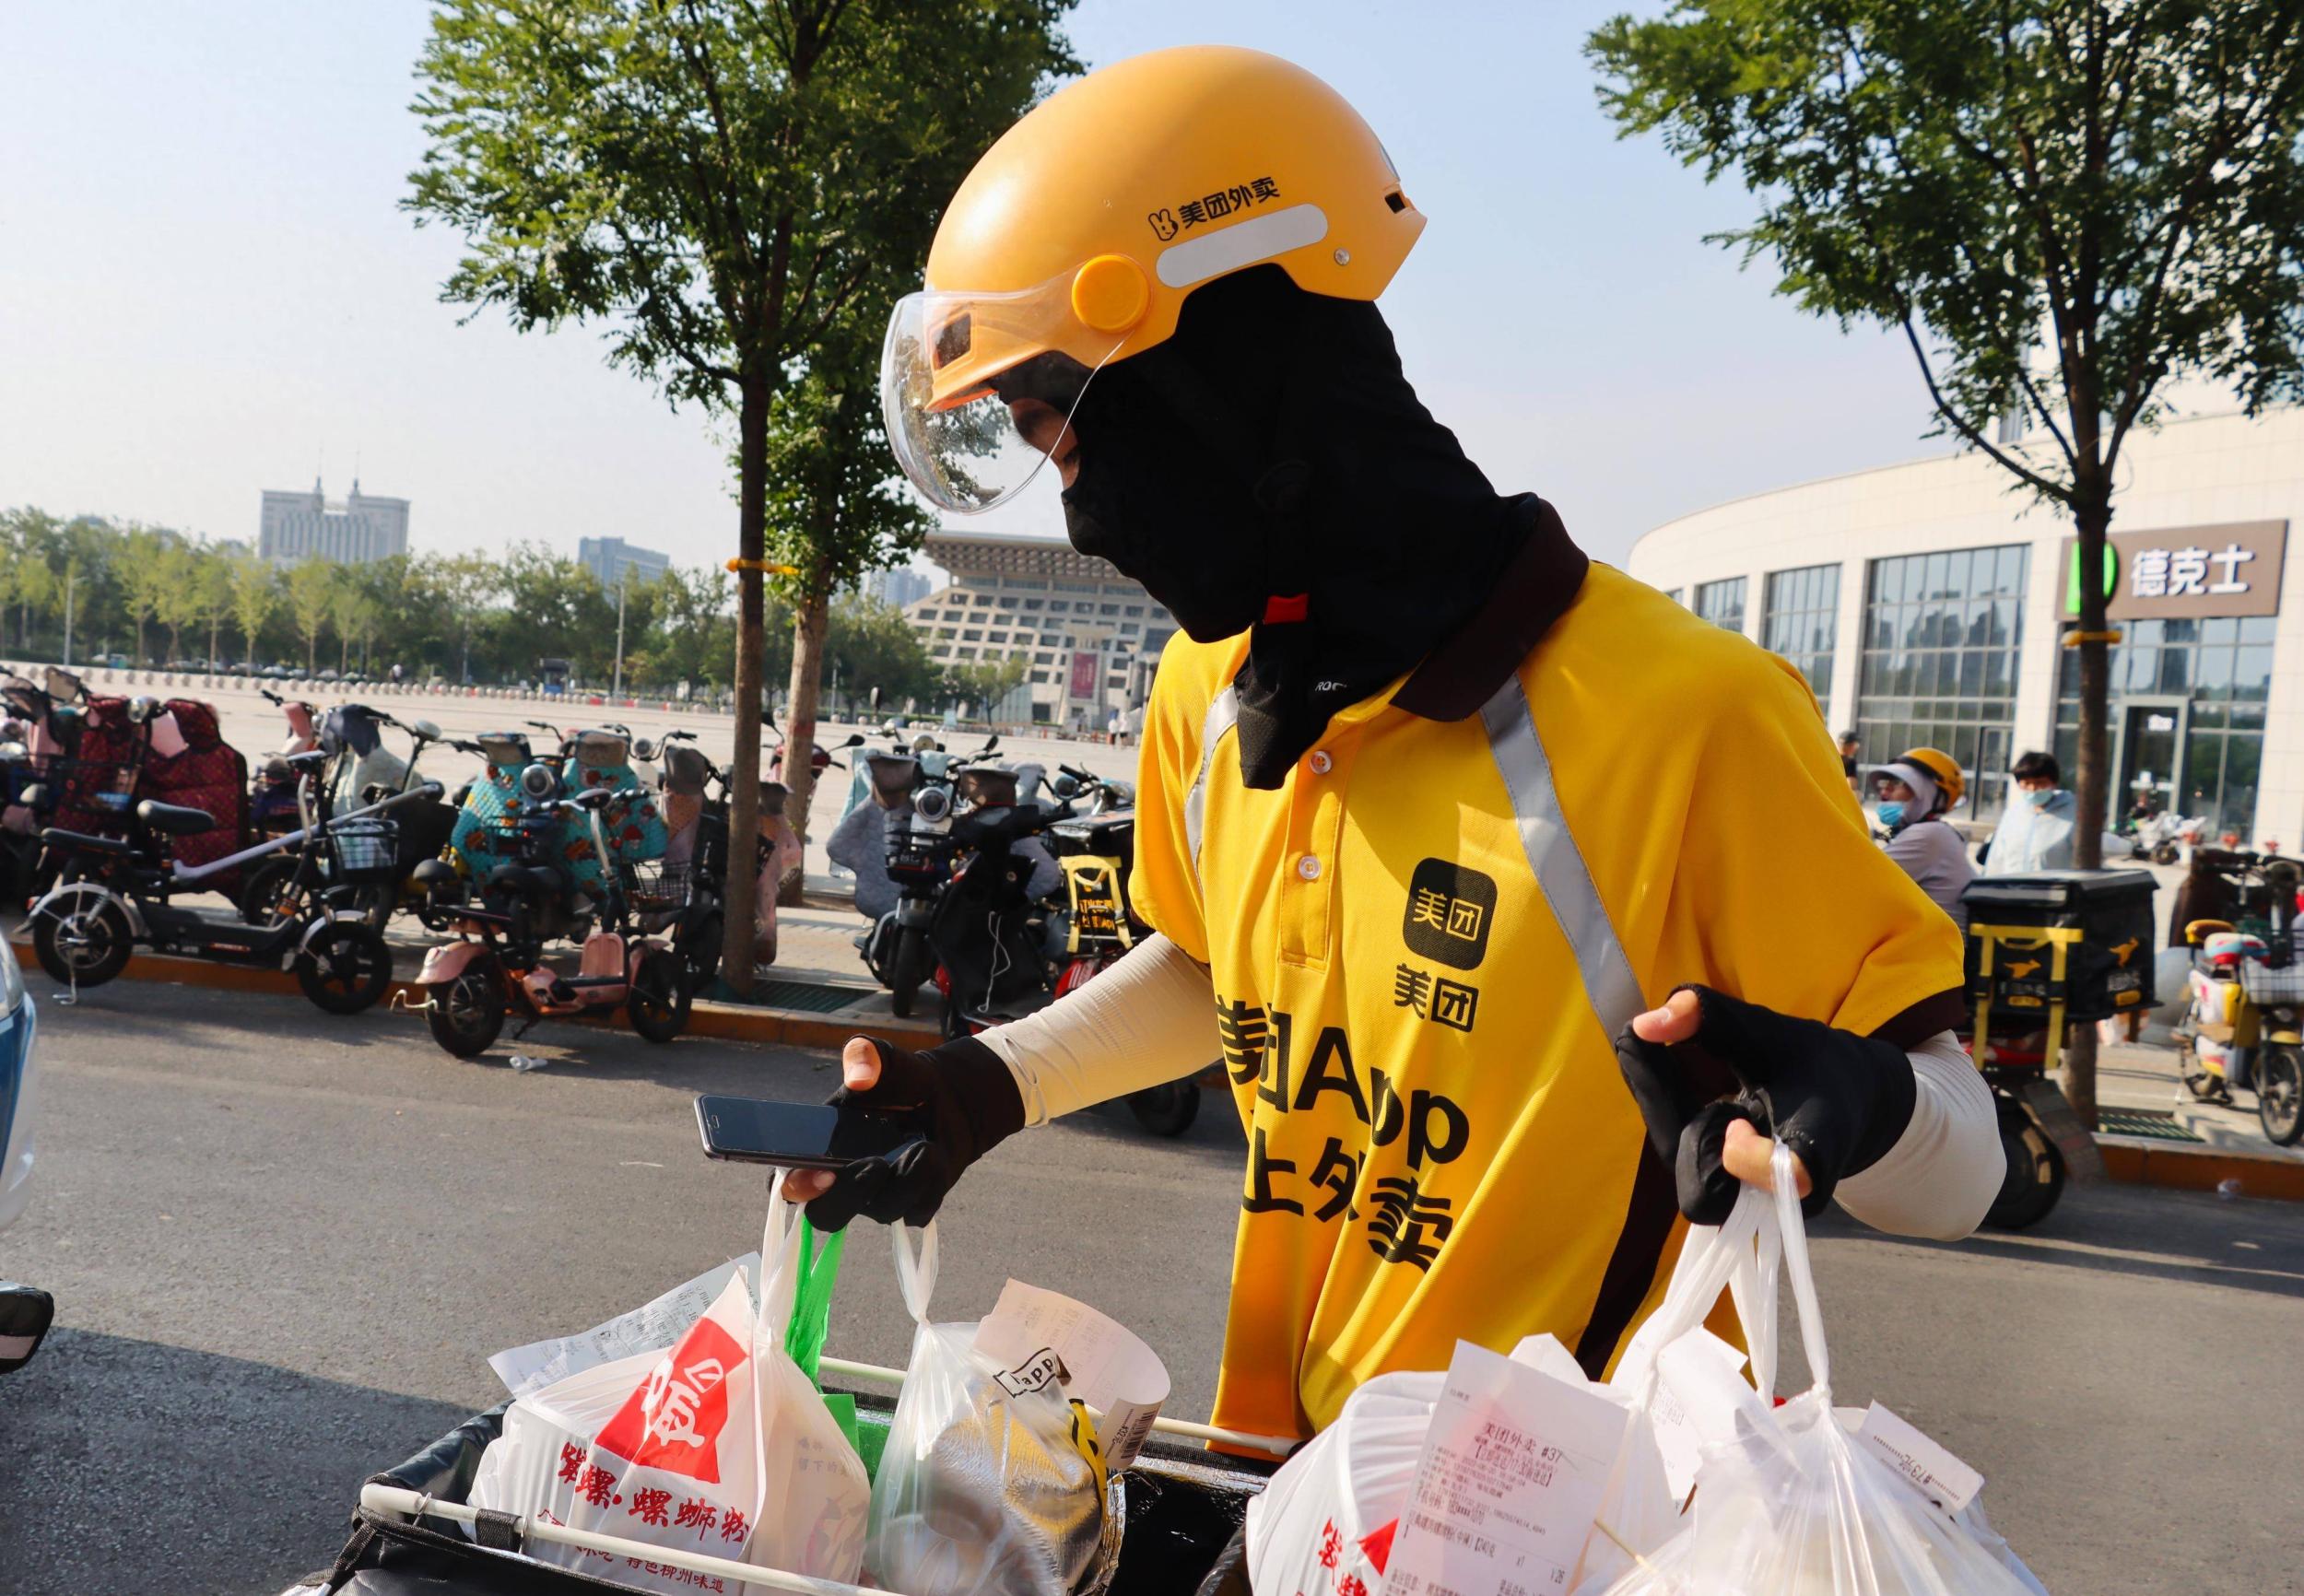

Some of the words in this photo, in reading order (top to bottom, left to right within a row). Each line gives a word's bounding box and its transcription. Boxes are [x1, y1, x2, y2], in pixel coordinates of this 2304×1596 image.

[1178, 176, 1280, 229] 美团外卖
[2130, 544, 2255, 597] 德克士
[1413, 886, 1484, 942] 美团
[1393, 963, 1479, 1033] 美团
